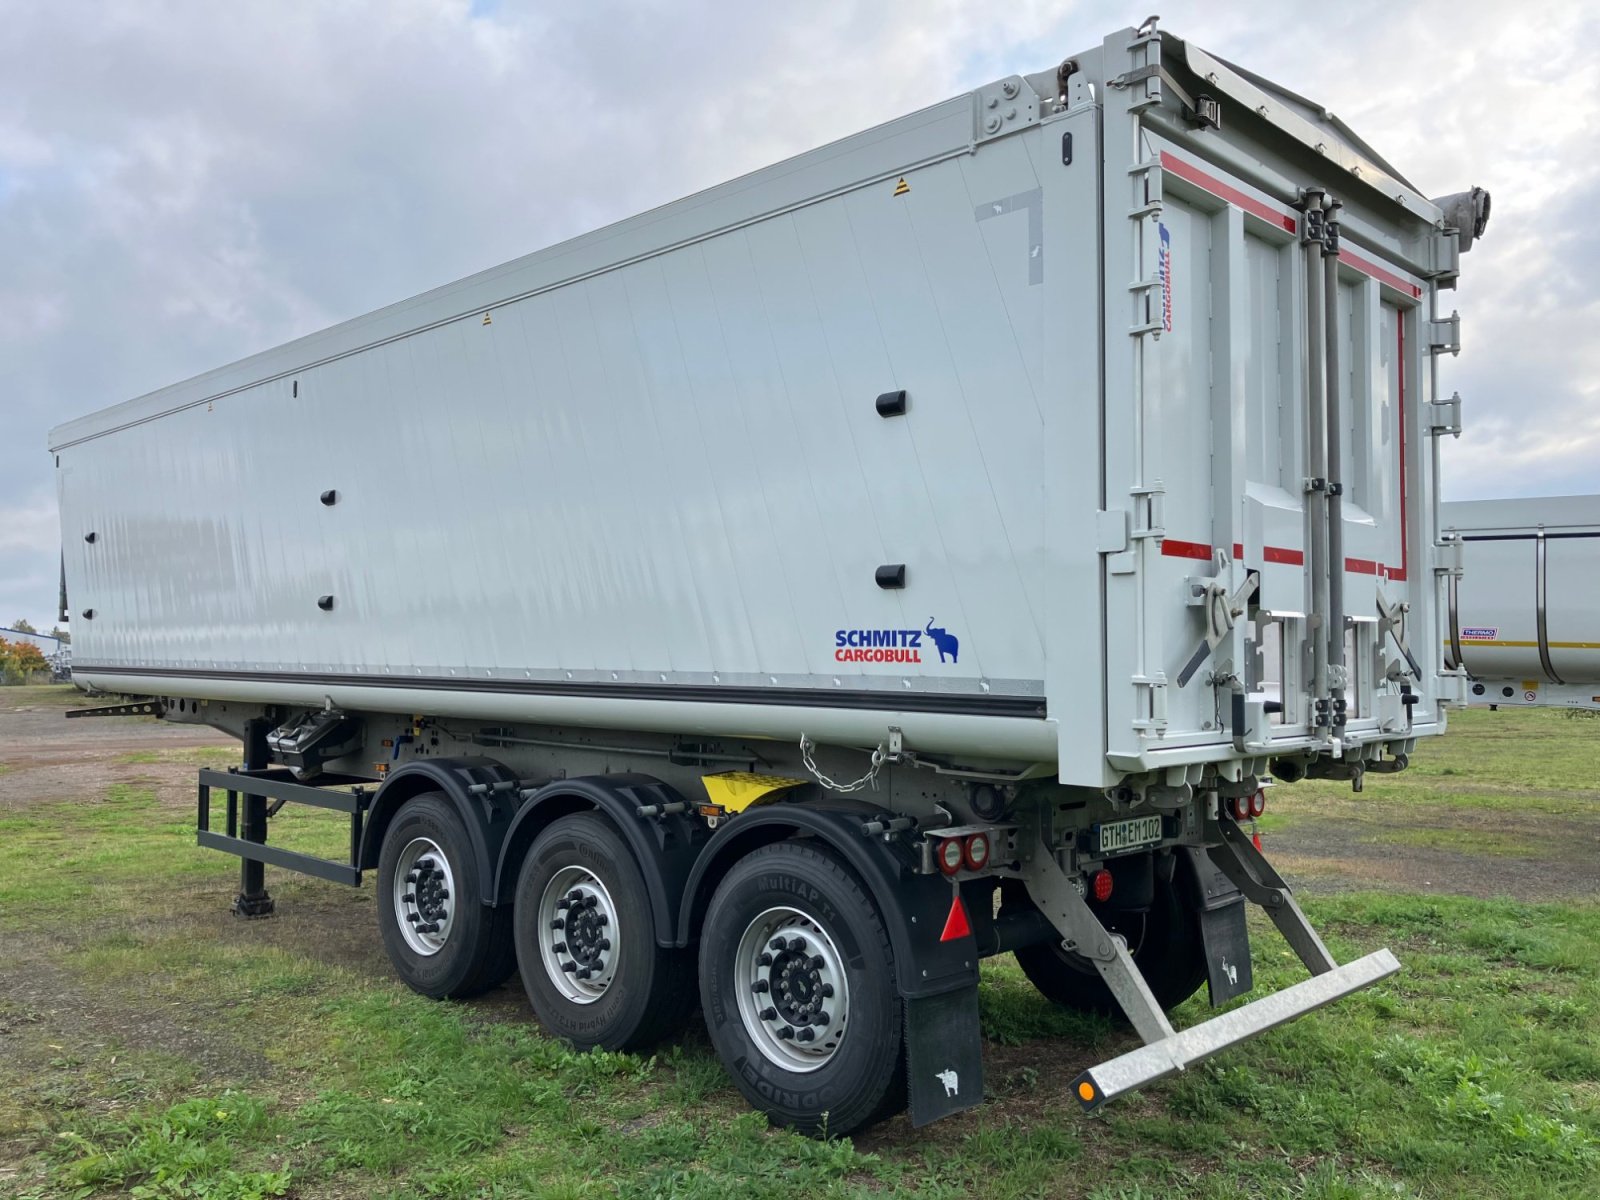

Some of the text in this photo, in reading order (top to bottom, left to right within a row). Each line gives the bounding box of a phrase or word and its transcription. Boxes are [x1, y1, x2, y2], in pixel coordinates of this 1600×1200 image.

[835, 630, 922, 647] SCHMITZ
[835, 649, 921, 662] CARGOBULL
[1101, 824, 1122, 848] GTH
